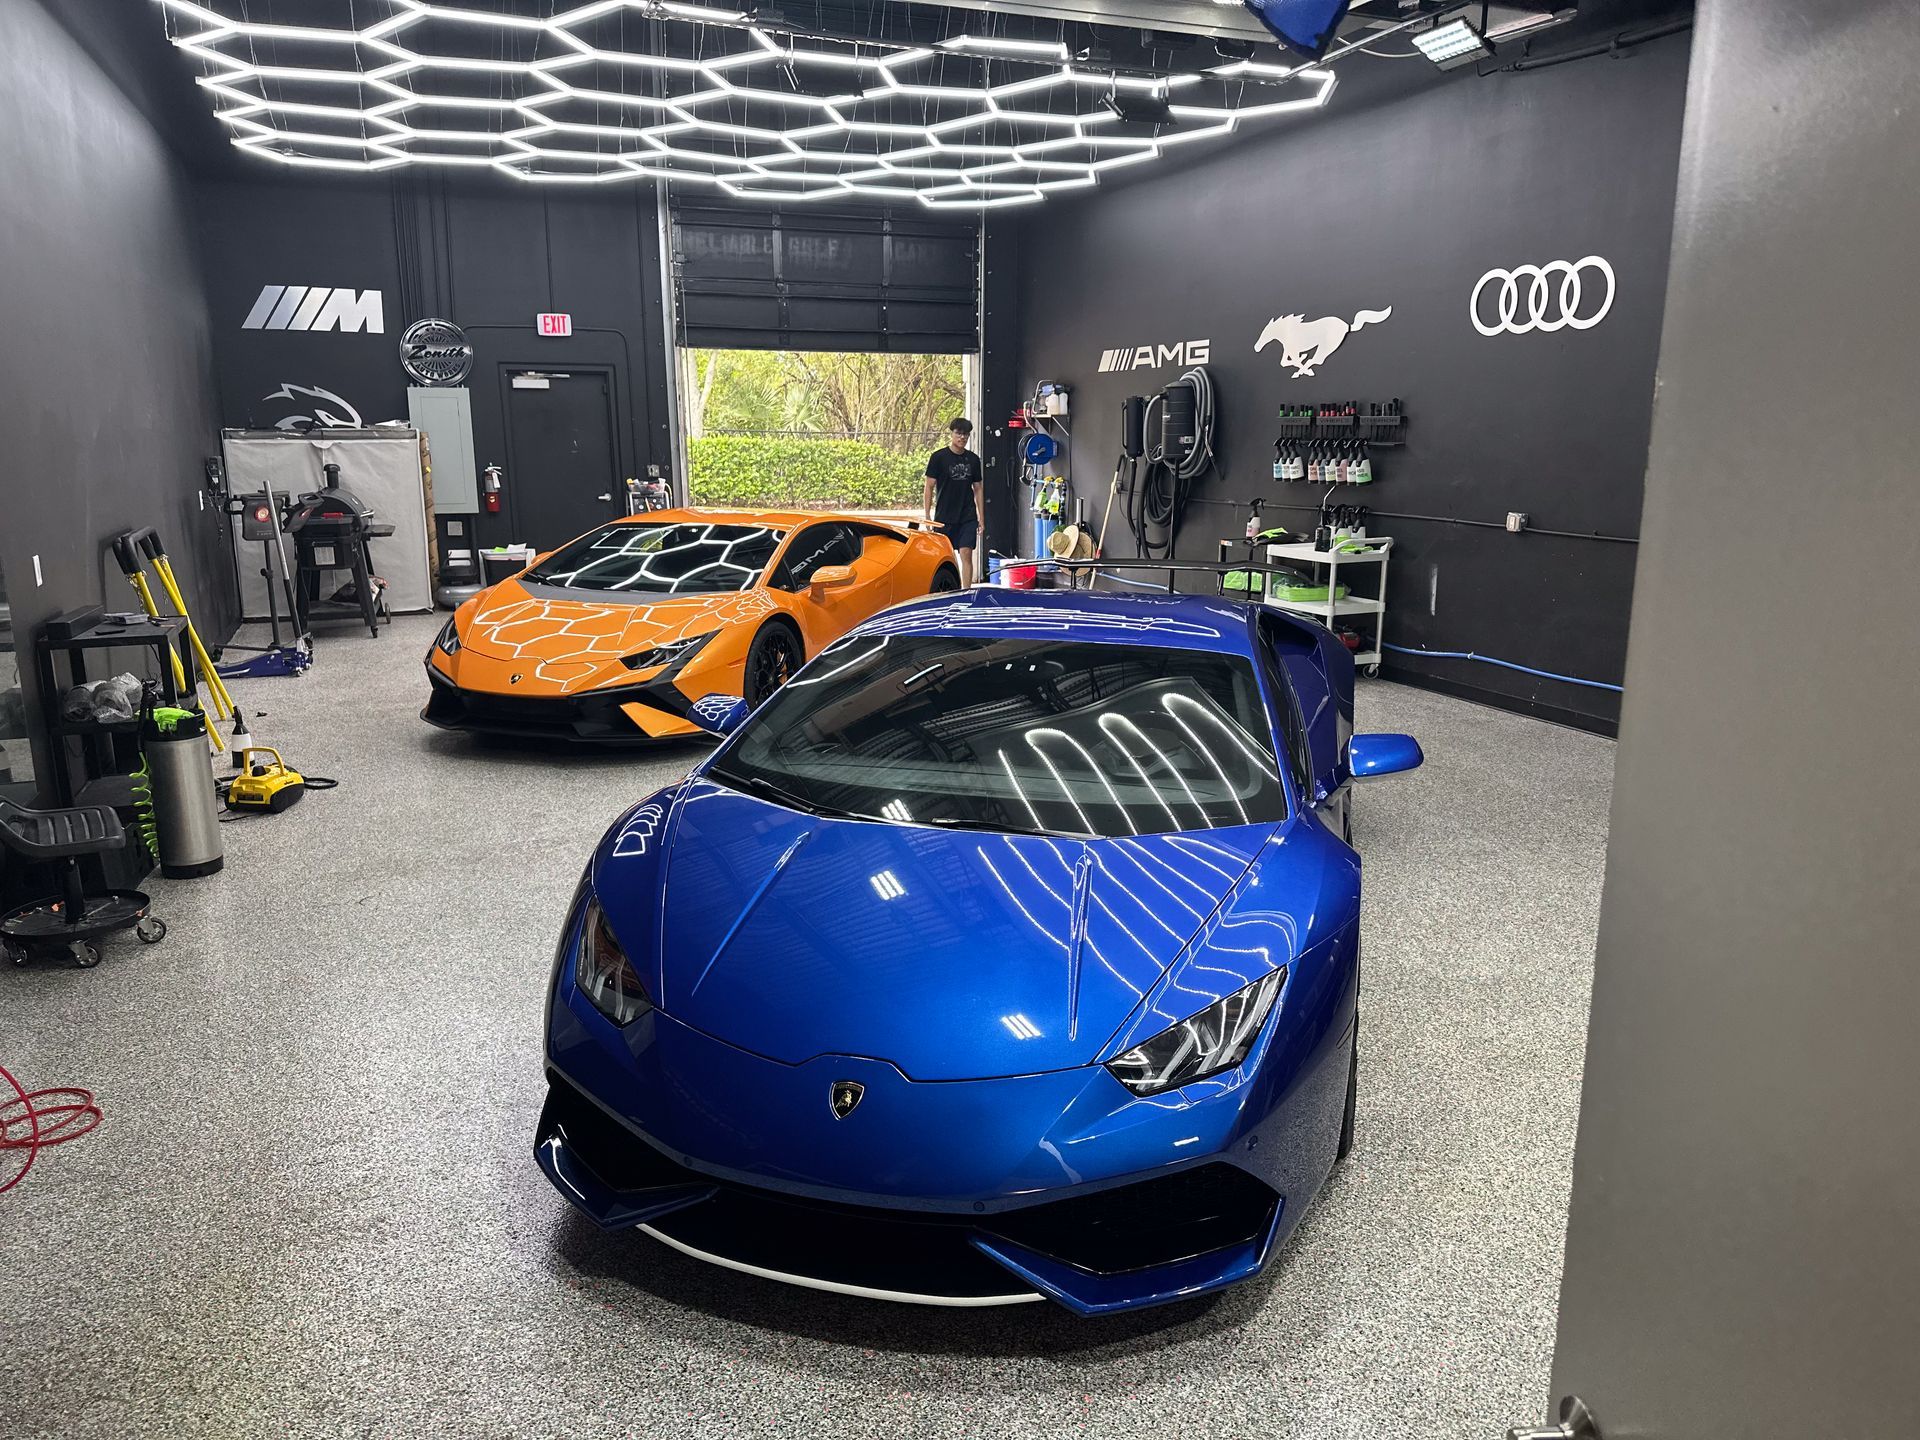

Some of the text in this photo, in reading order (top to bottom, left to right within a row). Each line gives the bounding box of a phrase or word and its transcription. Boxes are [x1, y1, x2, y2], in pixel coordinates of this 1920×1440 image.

[543, 315, 567, 334] EXIT
[407, 344, 465, 360] Zenith
[1131, 339, 1210, 371] AMG
[415, 363, 462, 379] AUTO WORKS
